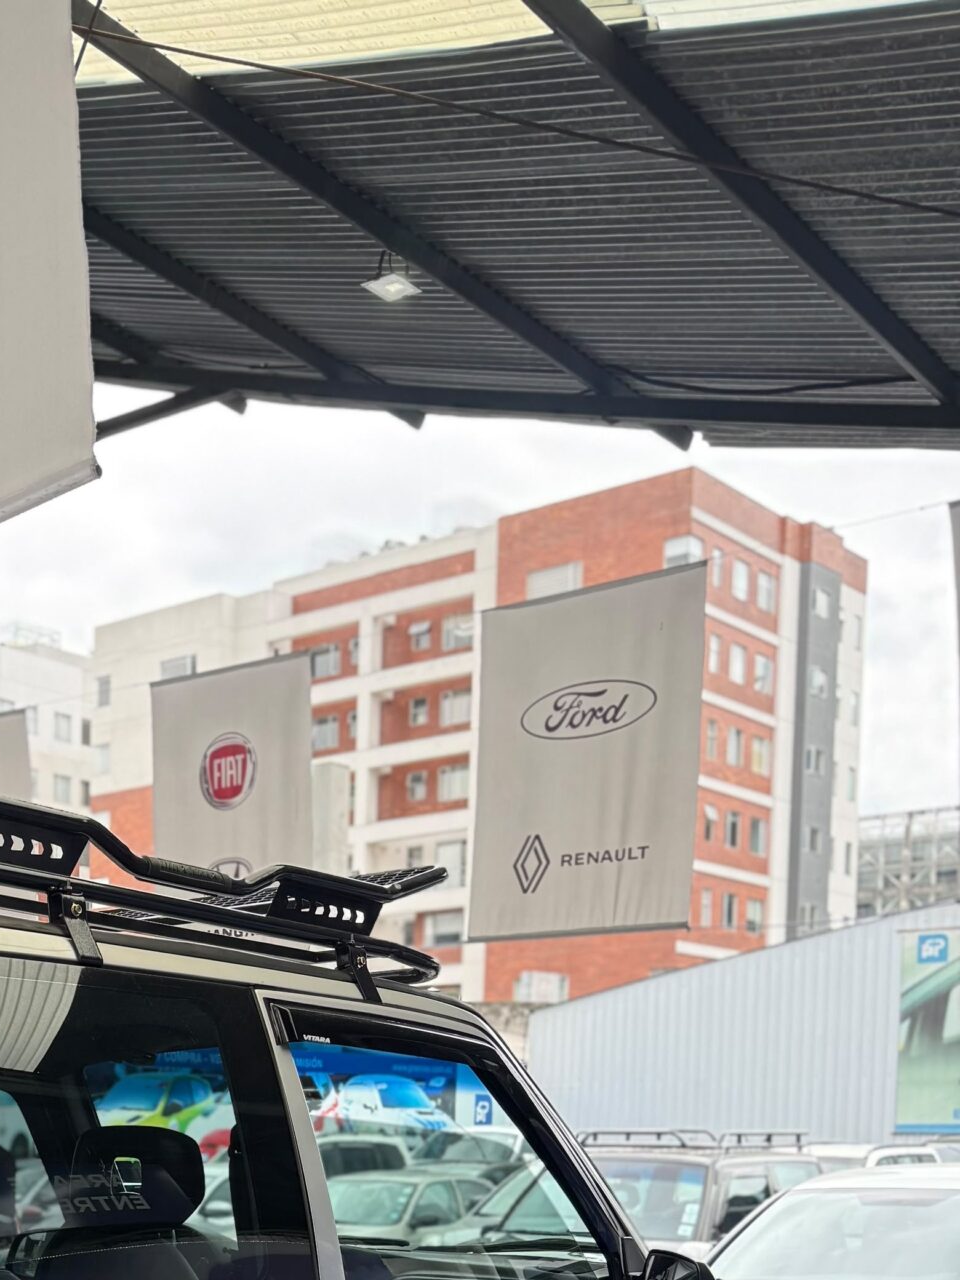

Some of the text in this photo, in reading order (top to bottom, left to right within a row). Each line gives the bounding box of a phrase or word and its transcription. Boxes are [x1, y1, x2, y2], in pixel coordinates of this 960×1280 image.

[544, 688, 628, 731] Ford
[212, 753, 244, 789] FIAT
[559, 845, 650, 867] RENAULT
[303, 1034, 331, 1044] VITARA
